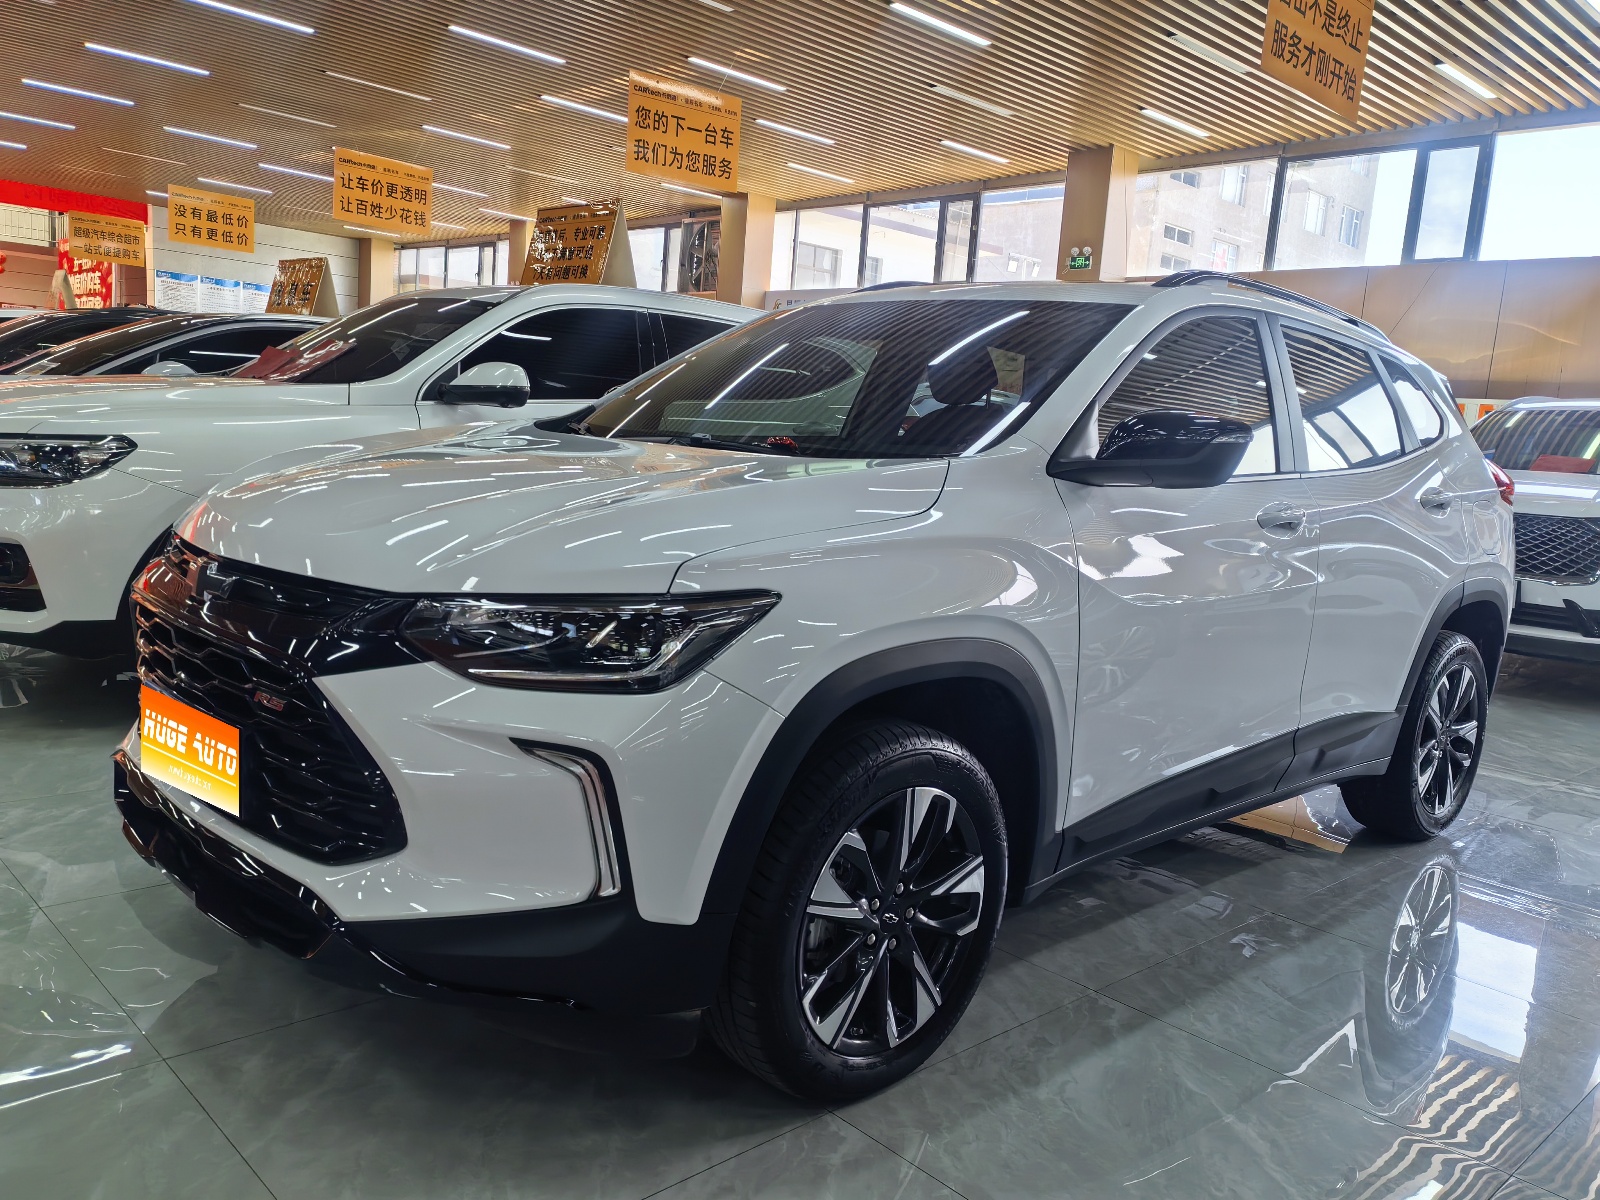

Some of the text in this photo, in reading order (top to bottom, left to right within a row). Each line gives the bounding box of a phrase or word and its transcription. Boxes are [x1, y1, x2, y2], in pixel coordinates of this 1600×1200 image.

[1271, 19, 1357, 103] 服务才刚开始
[635, 105, 734, 149] 您的下一台车
[634, 139, 733, 180] 我们为您服务
[340, 172, 427, 205] 让车价更透明
[174, 203, 249, 228] 没有最低价
[340, 195, 426, 227] 让百姓少花钱
[73, 226, 140, 245] 超级汽车综合超市
[174, 222, 249, 246] 只有更低价
[73, 243, 140, 261] 一站式便捷购车
[253, 690, 287, 712] RS
